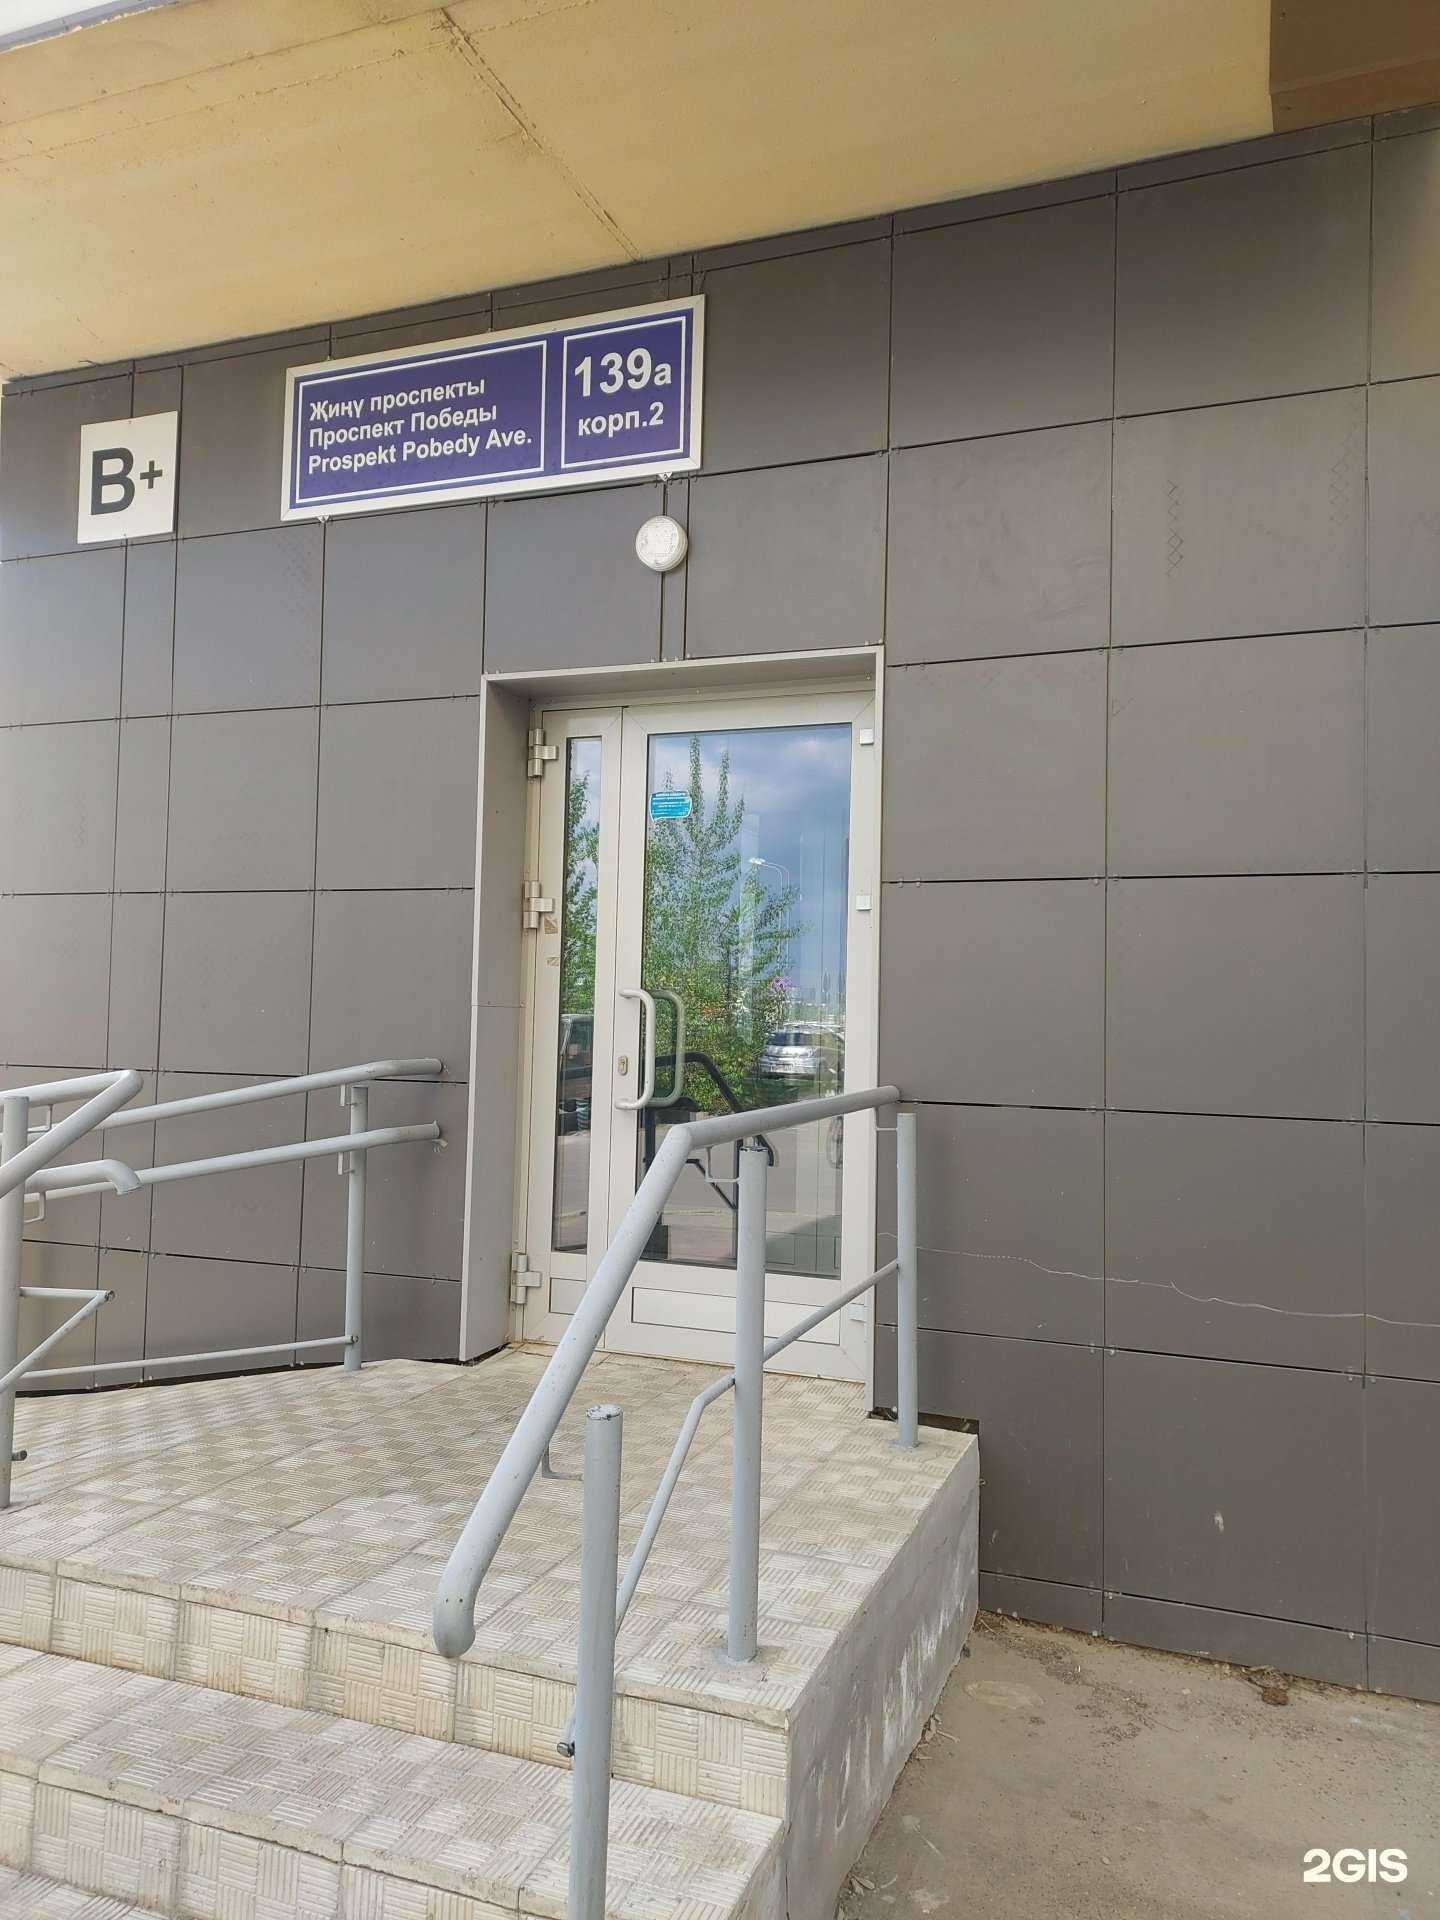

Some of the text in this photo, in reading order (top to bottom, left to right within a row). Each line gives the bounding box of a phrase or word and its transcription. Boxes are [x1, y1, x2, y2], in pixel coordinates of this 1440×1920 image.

[574, 347, 672, 397] 139а
[370, 379, 485, 414] проспекты
[309, 405, 497, 450] Проспект Победы
[578, 401, 664, 438] корп.2
[308, 428, 532, 475] Prospekt Pobedy Ave.
